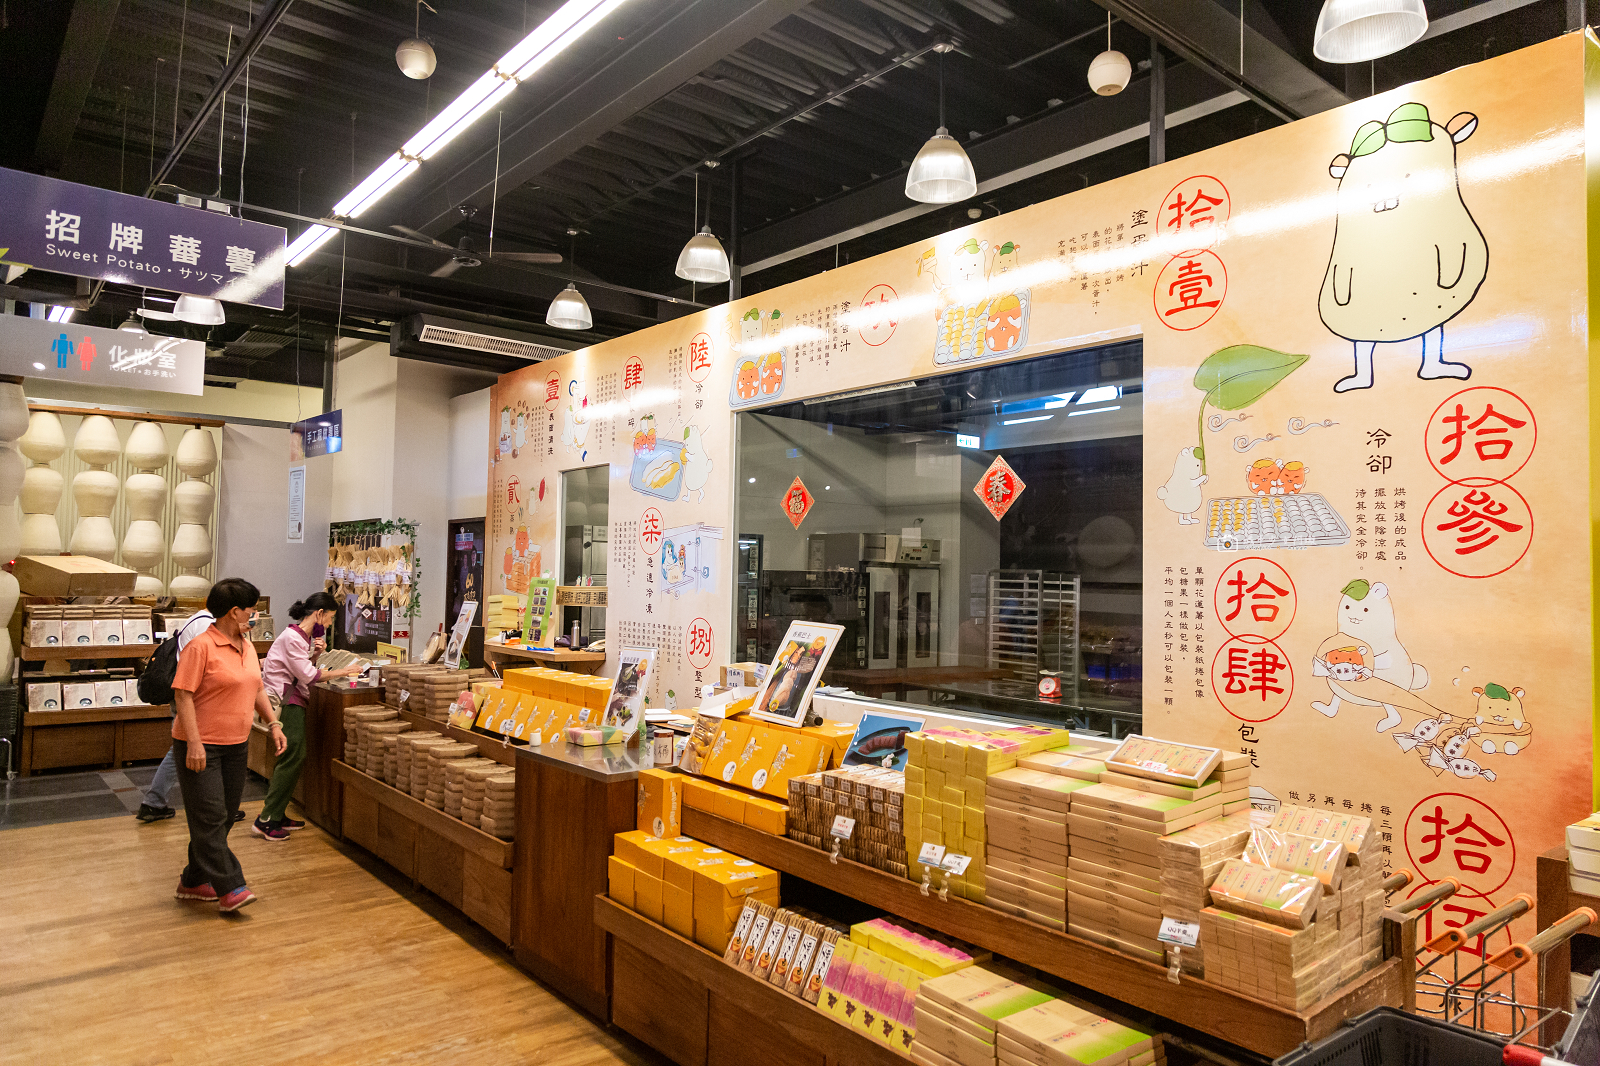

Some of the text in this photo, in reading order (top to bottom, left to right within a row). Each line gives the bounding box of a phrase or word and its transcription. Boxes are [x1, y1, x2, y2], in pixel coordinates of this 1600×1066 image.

[45, 209, 256, 275] 招牌蕃薯
[46, 243, 250, 289] Sweet Potato サツマイ
[690, 338, 712, 373] 陸
[624, 362, 643, 391] 肆
[1365, 428, 1393, 475] 冷卻
[985, 469, 1012, 503] 春
